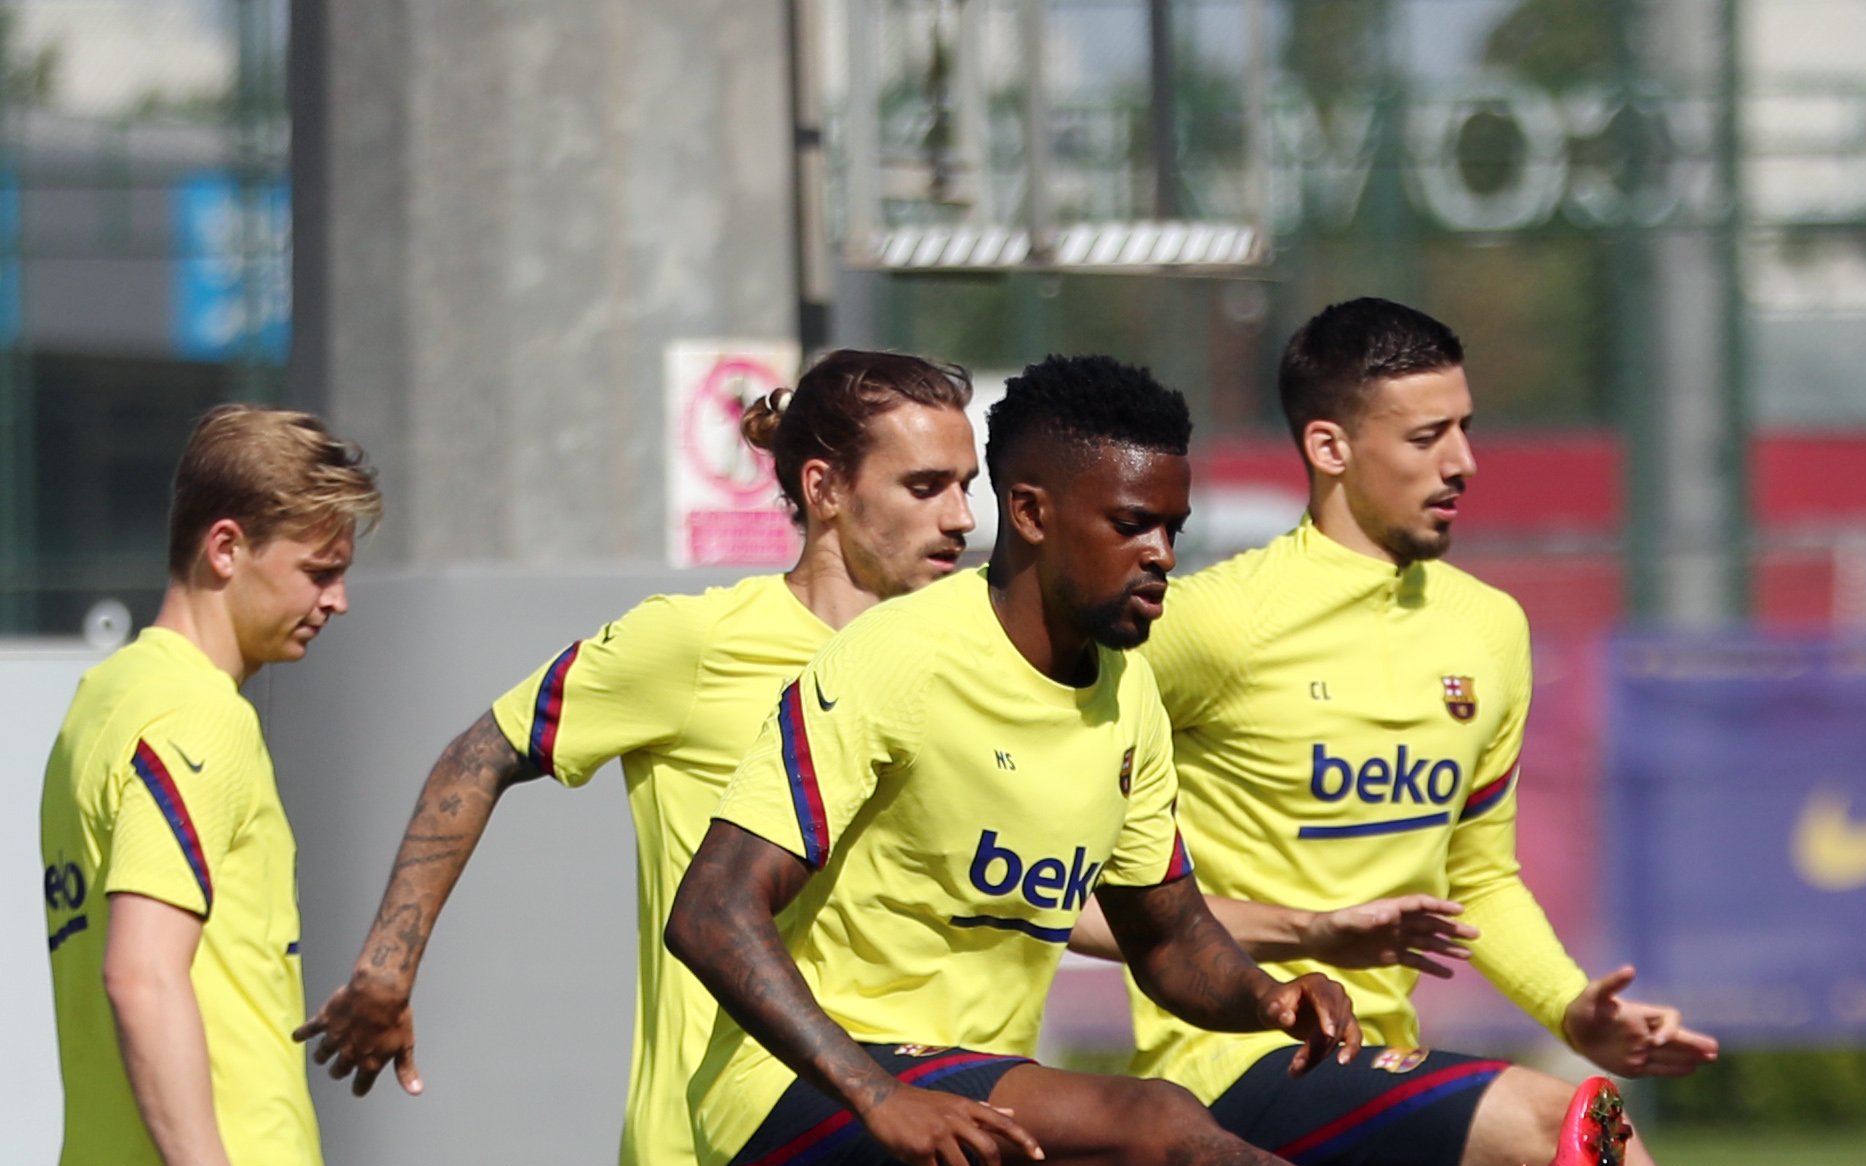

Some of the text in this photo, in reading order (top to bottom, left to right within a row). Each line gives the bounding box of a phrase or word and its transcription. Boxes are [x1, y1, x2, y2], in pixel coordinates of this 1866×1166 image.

[1310, 681, 1331, 701] CL
[994, 748, 1017, 772] NS
[1310, 743, 1462, 805] beko
[969, 829, 1102, 911] bek
